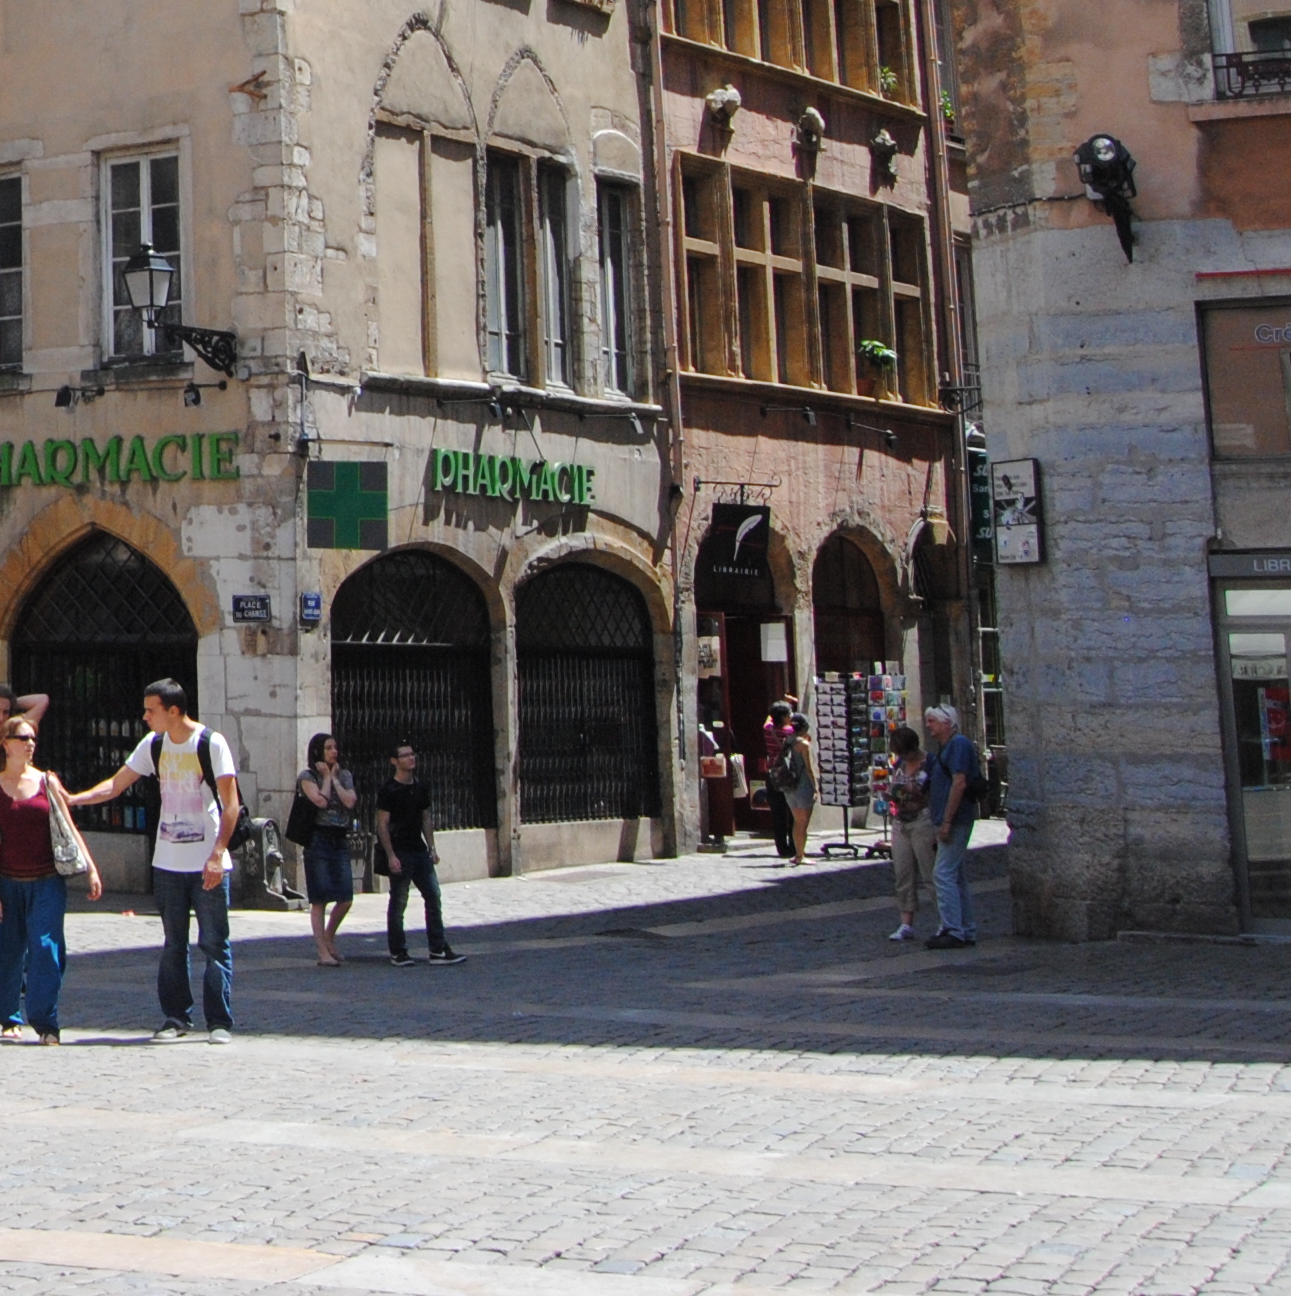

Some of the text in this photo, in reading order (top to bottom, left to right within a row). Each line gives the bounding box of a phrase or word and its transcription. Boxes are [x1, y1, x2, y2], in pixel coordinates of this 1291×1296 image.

[432, 448, 597, 504] PHARMACIE
[713, 565, 759, 576] LIBRAIRIE
[1252, 558, 1291, 572] LIBR
